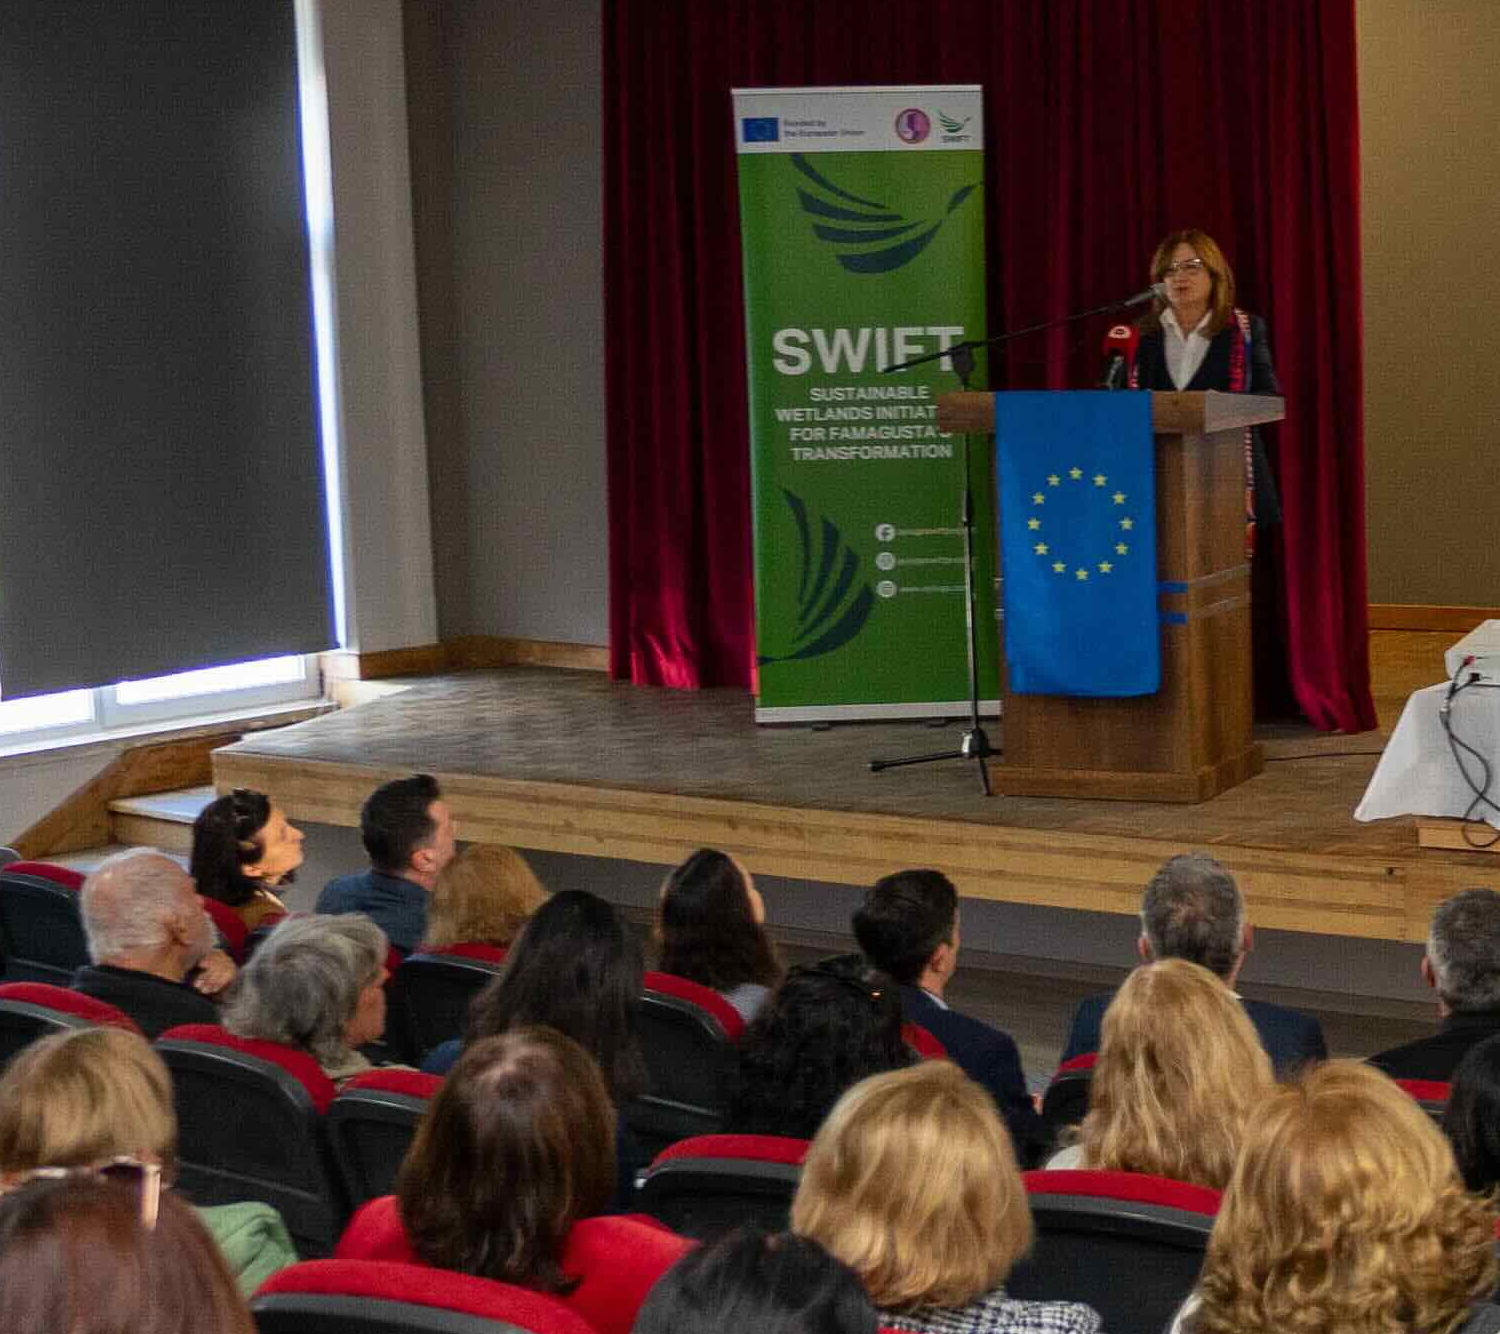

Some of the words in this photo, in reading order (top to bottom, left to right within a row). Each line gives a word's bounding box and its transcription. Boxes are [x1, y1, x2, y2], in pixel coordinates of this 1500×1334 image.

[772, 326, 965, 376] SWIFT
[810, 386, 930, 401] SUSTAINABLE
[775, 407, 873, 422] WETLANDS
[876, 406, 938, 420] INITIAT
[790, 428, 826, 441] FOR
[830, 425, 952, 440] FAMAGUSTA
[791, 444, 952, 460] TRANSFORMATION
